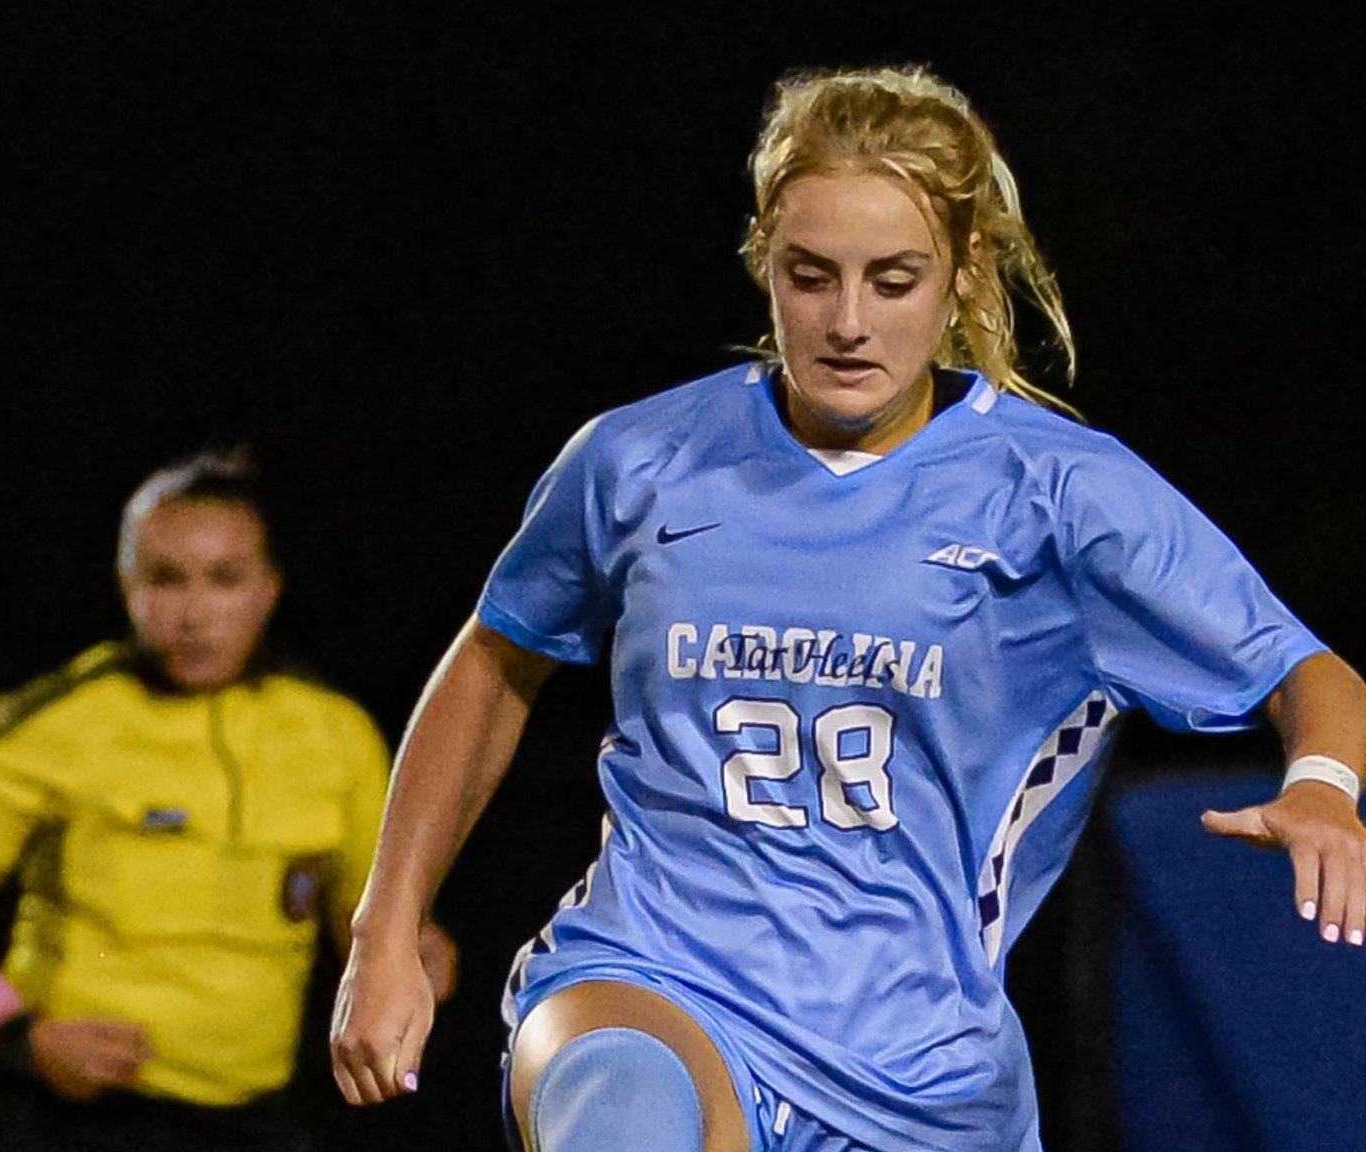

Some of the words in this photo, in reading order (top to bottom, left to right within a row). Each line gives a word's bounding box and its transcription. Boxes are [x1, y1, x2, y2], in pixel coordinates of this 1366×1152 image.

[667, 622, 943, 699] CAROLINA
[718, 632, 790, 674] Tar
[790, 633, 901, 683] Heels
[713, 695, 899, 831] 28
